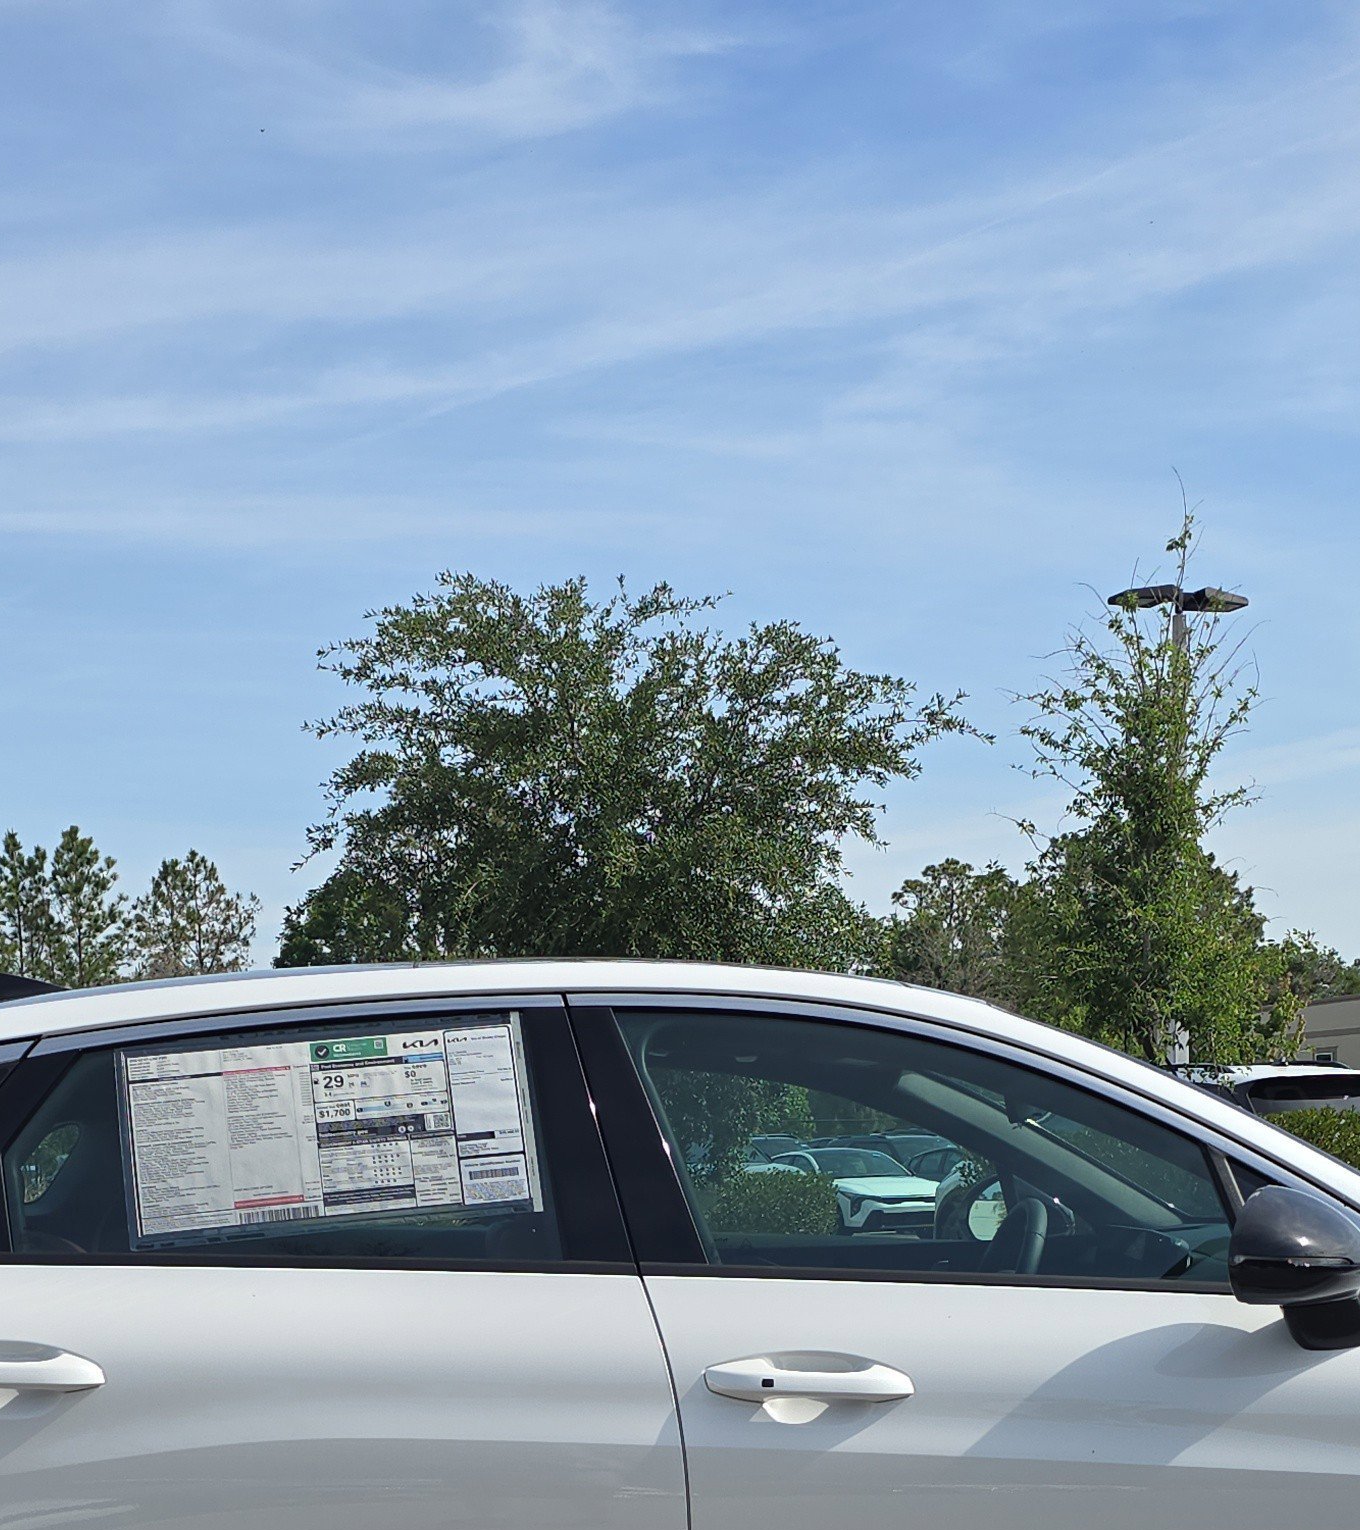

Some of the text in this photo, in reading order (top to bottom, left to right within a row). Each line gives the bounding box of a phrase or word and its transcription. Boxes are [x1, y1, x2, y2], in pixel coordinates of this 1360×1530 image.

[332, 1044, 347, 1053] CR
[402, 1039, 439, 1049] KIA
[404, 1070, 417, 1079] $0
[322, 1075, 344, 1089] 29
[318, 1108, 351, 1119] $1,700
